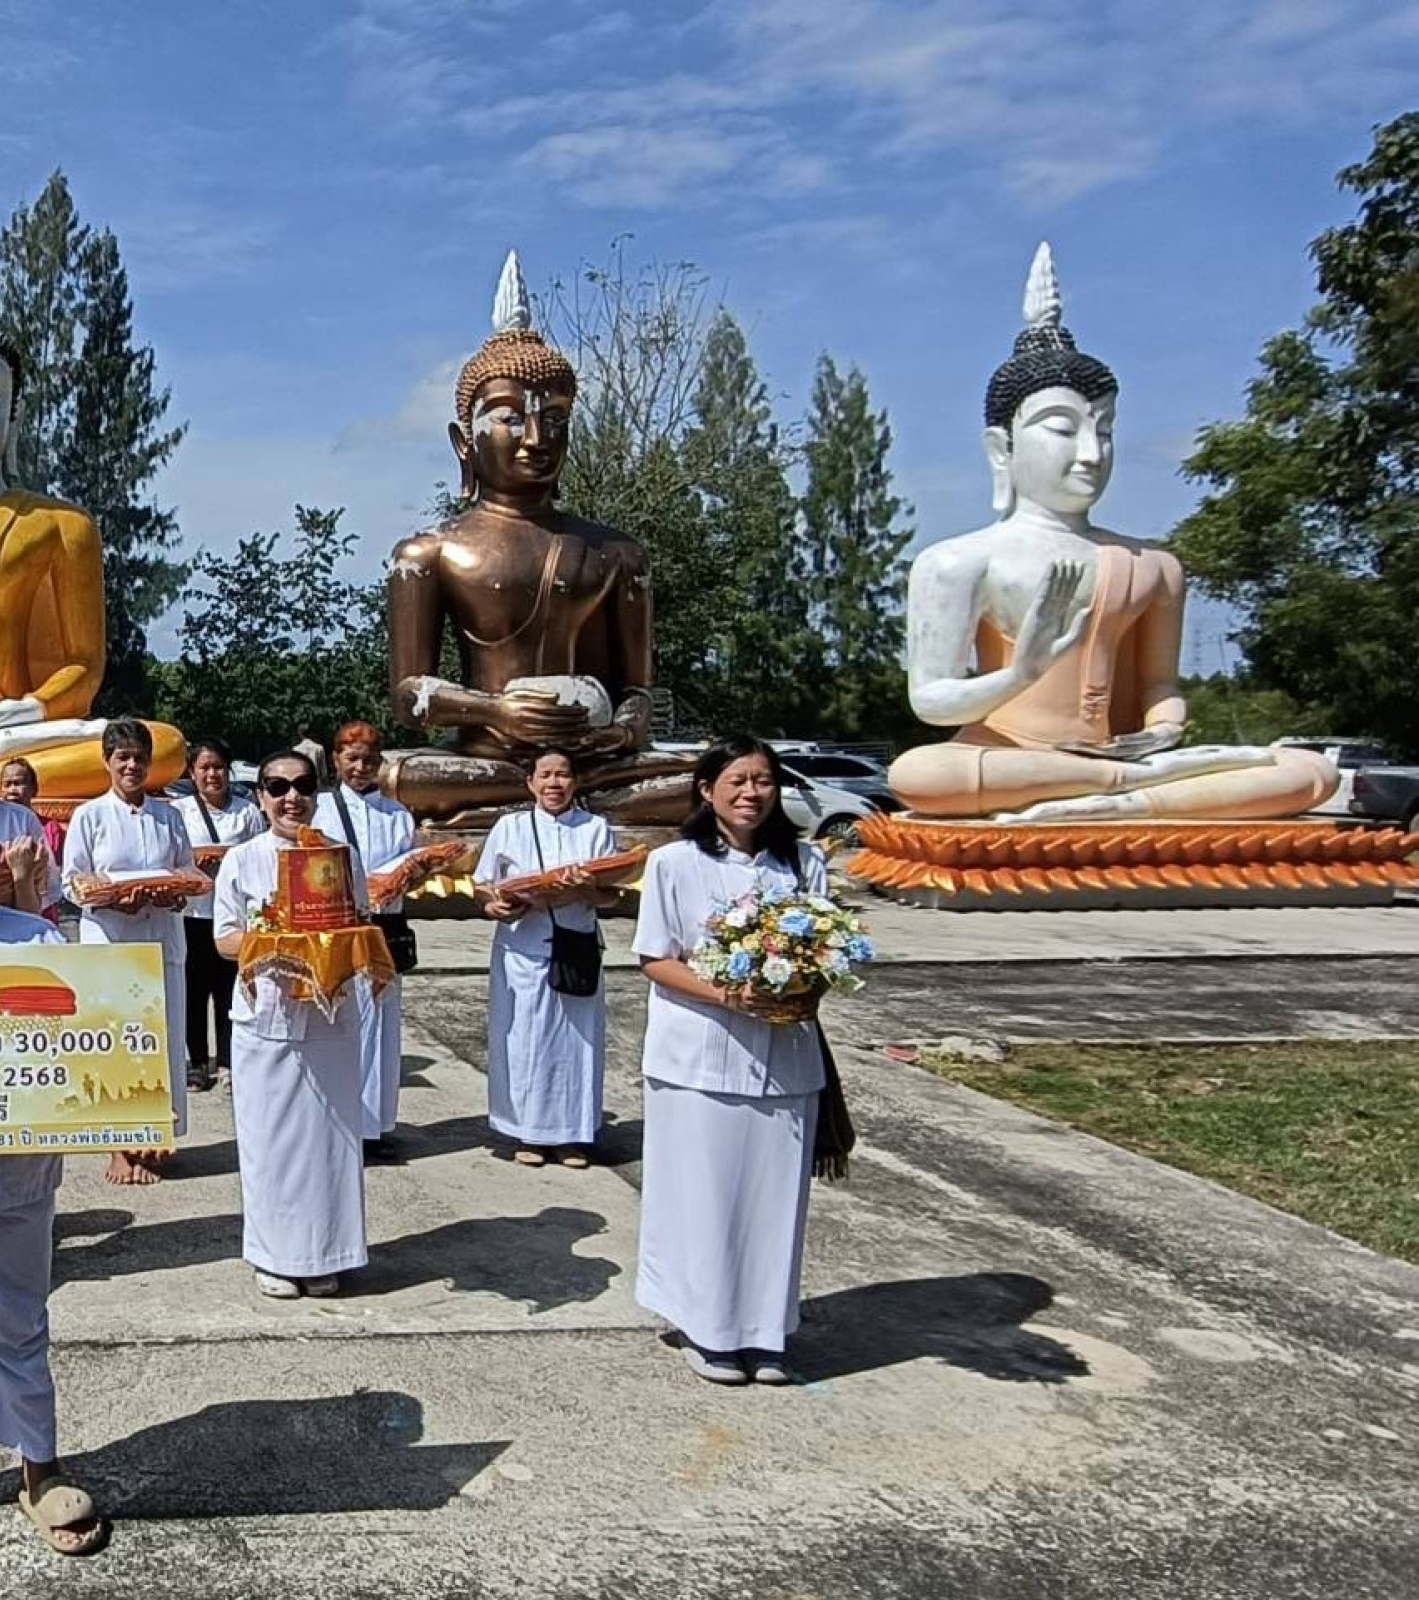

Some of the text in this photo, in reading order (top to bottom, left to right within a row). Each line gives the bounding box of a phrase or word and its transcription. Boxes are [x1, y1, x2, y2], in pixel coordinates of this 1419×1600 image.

[15, 1031, 112, 1057] 30,000
[123, 1024, 158, 1053] วัด
[4, 1066, 67, 1087] 2568
[20, 1129, 32, 1146] ปี
